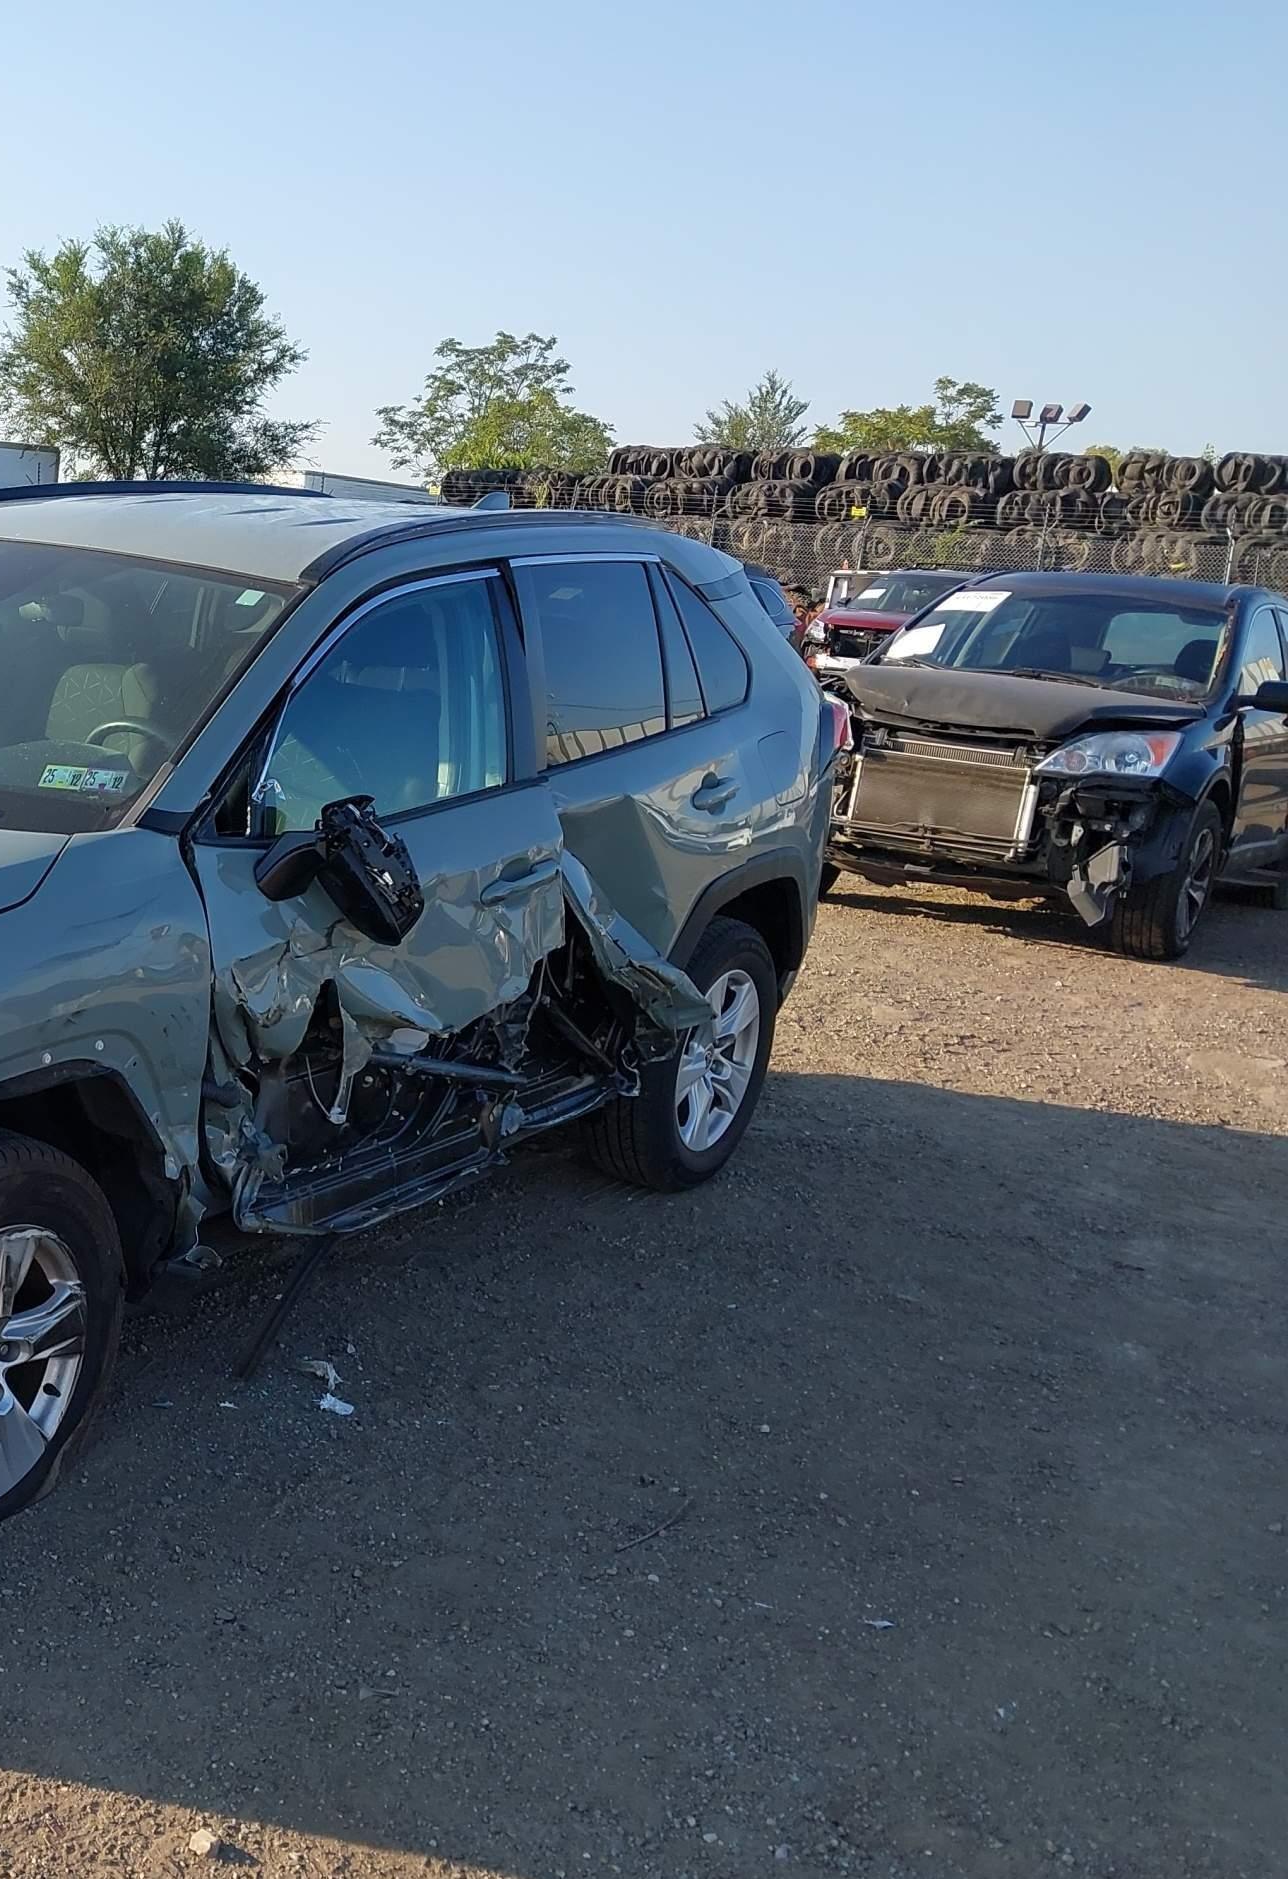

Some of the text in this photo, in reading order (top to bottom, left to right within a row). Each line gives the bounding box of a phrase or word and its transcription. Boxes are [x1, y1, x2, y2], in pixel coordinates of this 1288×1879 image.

[43, 768, 82, 787] 25 12
[85, 771, 99, 786] 25
[112, 776, 124, 789] 12
